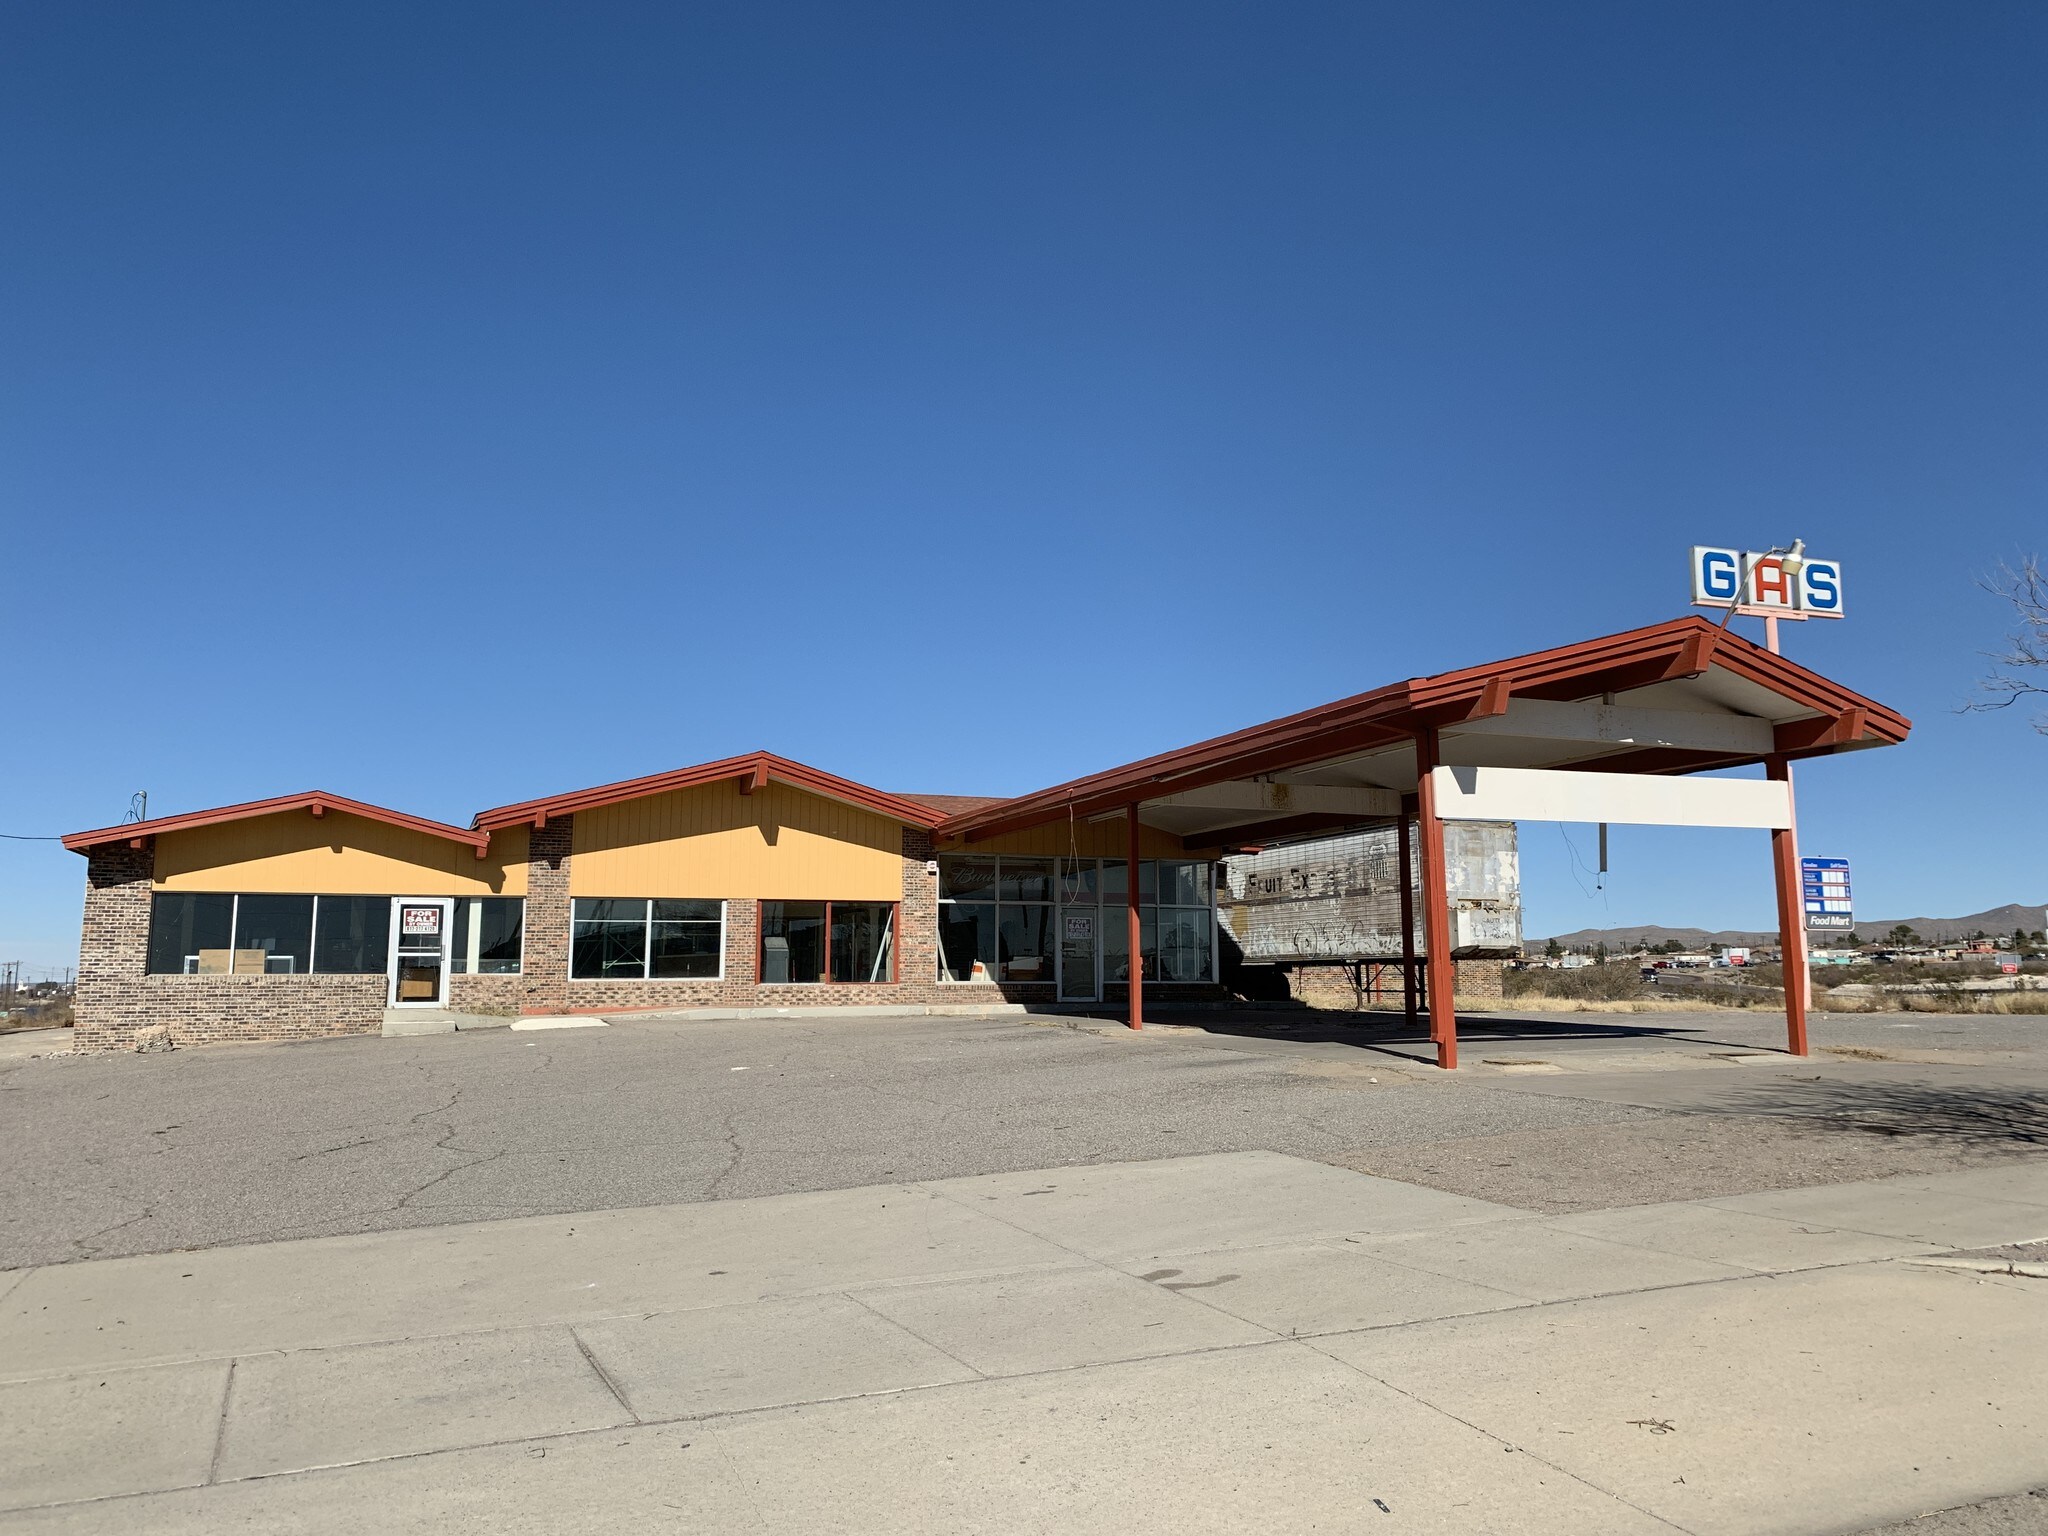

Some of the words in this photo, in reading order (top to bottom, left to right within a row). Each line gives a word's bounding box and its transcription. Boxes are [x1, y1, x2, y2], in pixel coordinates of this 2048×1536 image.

[1702, 551, 1838, 608] GAS
[1248, 872, 1283, 896] FUIT
[1810, 915, 1830, 925] Food
[1830, 916, 1850, 926] Mart
